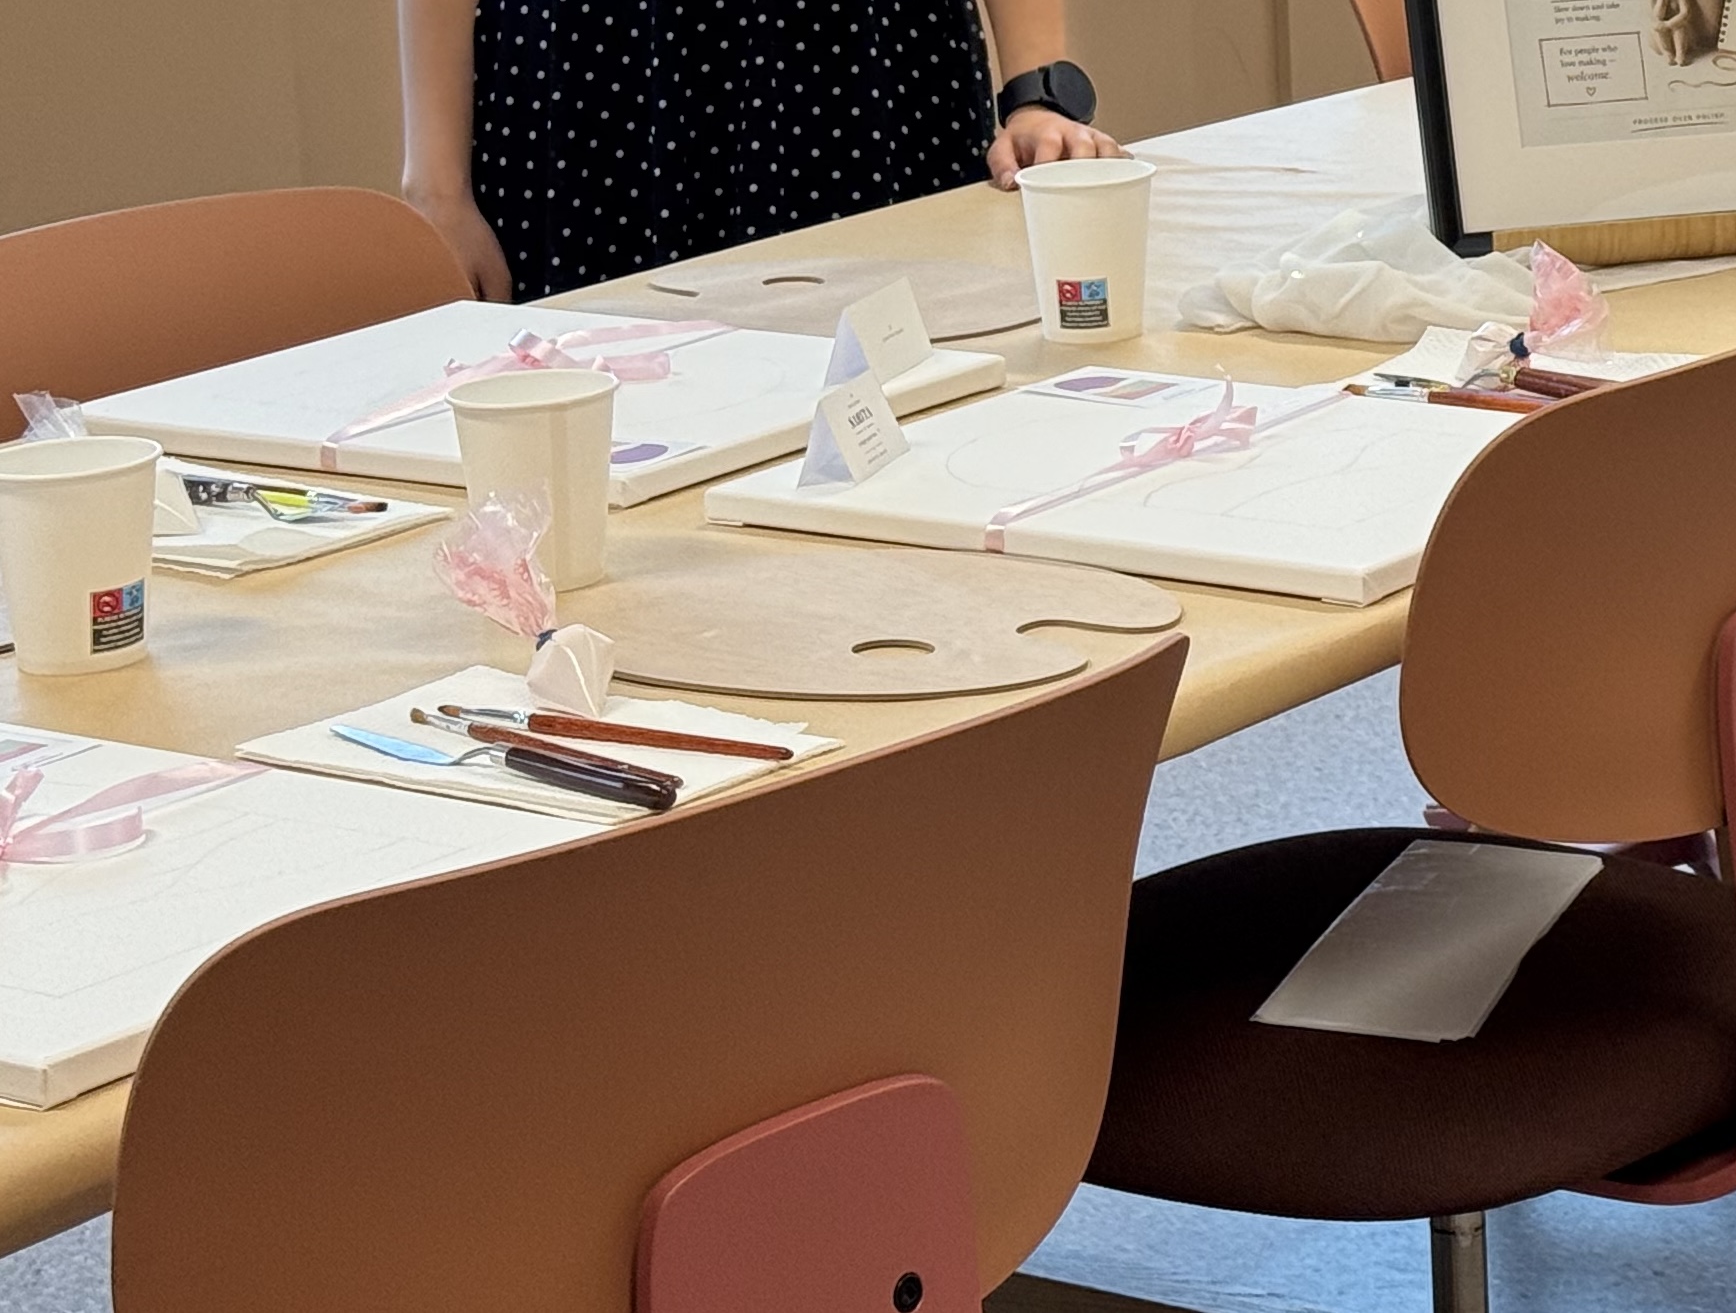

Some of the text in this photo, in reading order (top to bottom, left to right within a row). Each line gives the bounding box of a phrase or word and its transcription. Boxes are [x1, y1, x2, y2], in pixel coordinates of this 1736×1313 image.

[1559, 44, 1618, 57] For people who
[1577, 57, 1607, 67] making
[1633, 115, 1668, 125] PROCESS
